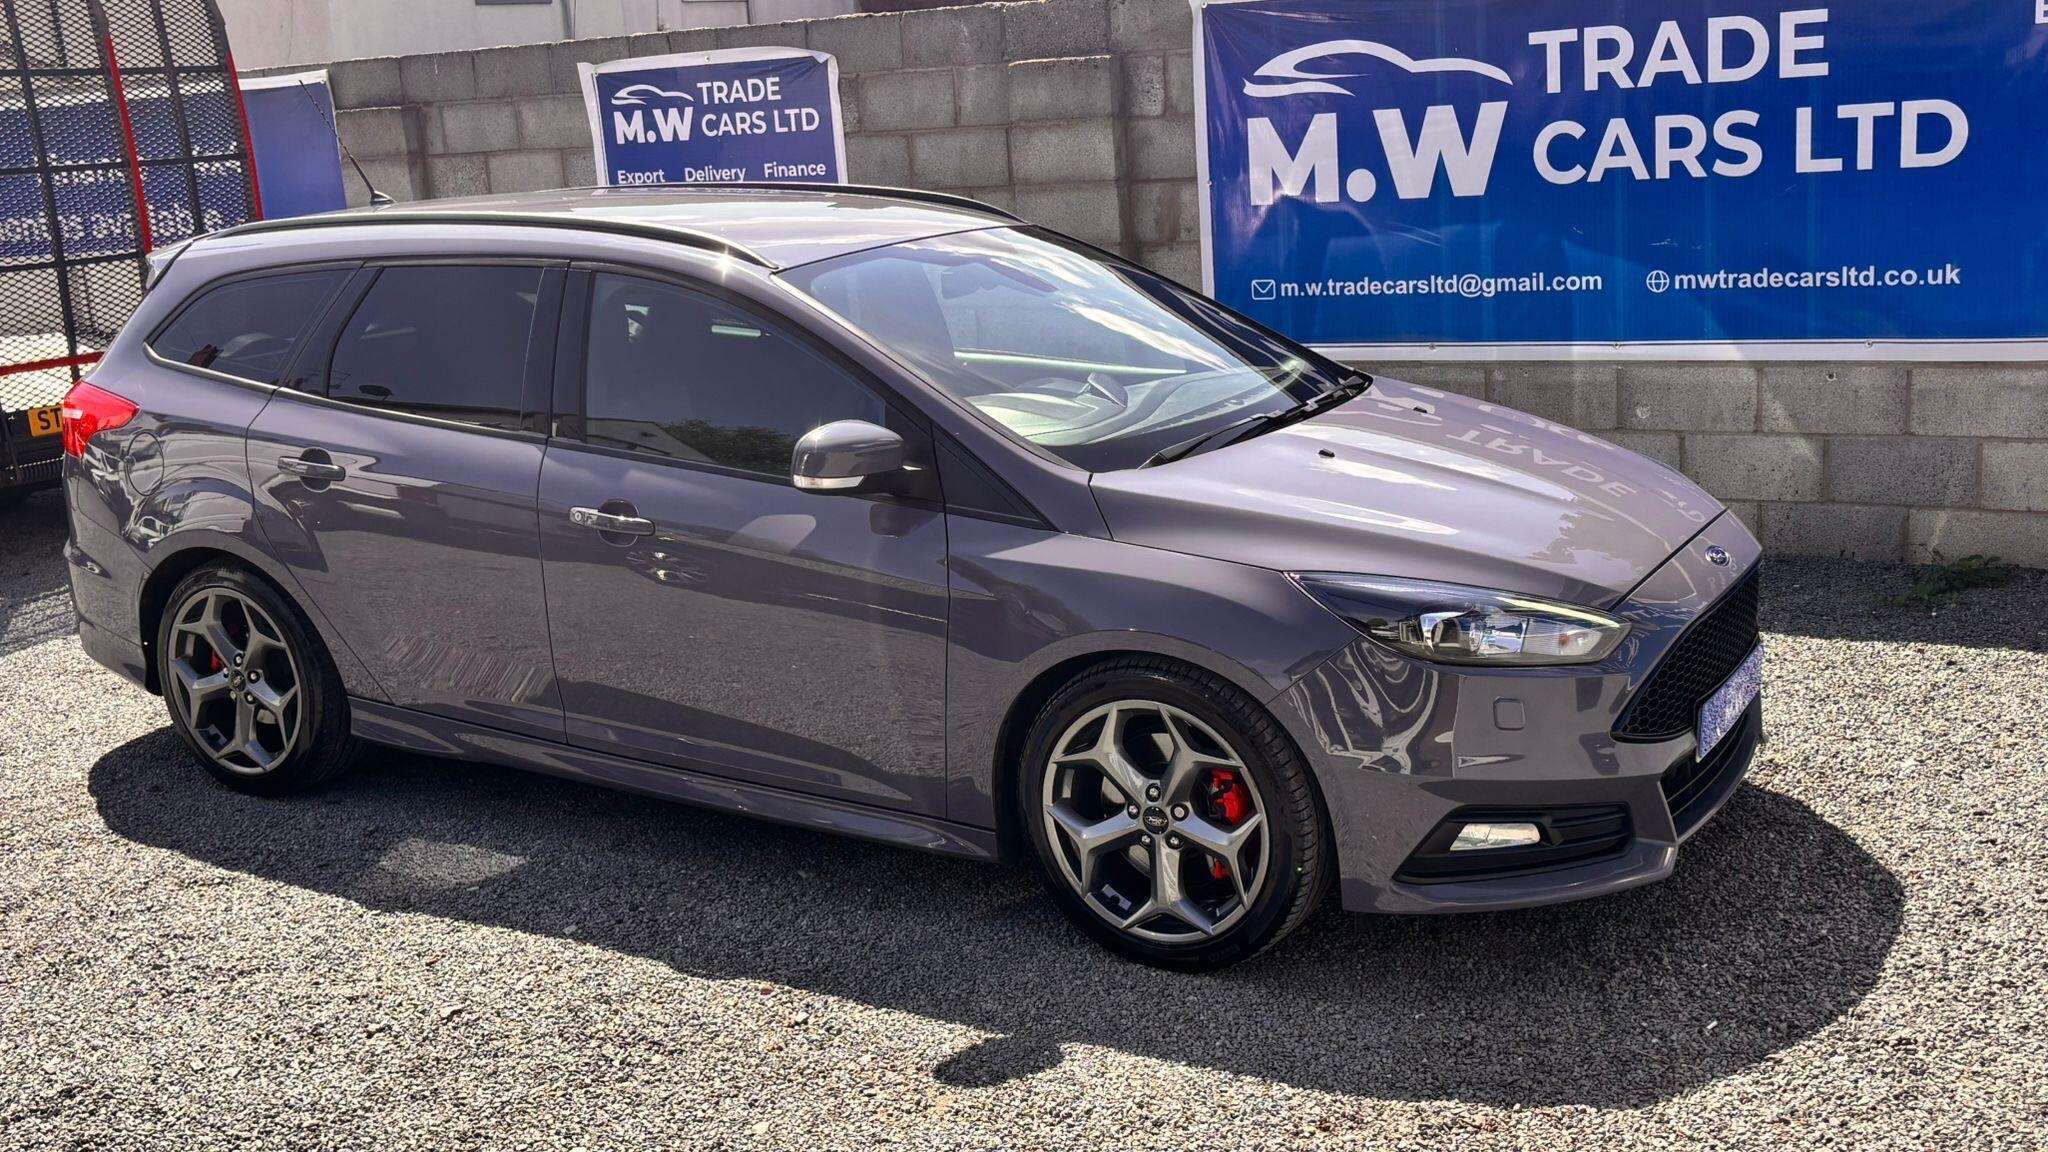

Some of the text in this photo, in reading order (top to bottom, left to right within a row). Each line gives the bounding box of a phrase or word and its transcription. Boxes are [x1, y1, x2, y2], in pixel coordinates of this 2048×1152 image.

[1528, 8, 1830, 95] TRADE
[697, 77, 782, 105] TRADE
[613, 107, 694, 145] M.W
[701, 107, 820, 137] CARS LTD
[1246, 100, 1509, 206] M.W
[1532, 99, 1969, 185] CARS LTD
[617, 162, 826, 184] Export Delivery Finance
[1280, 272, 1603, 298] m.w.tradecarsltd@gmail.com
[1674, 264, 1961, 291] mwtradecarsltd.co.uk
